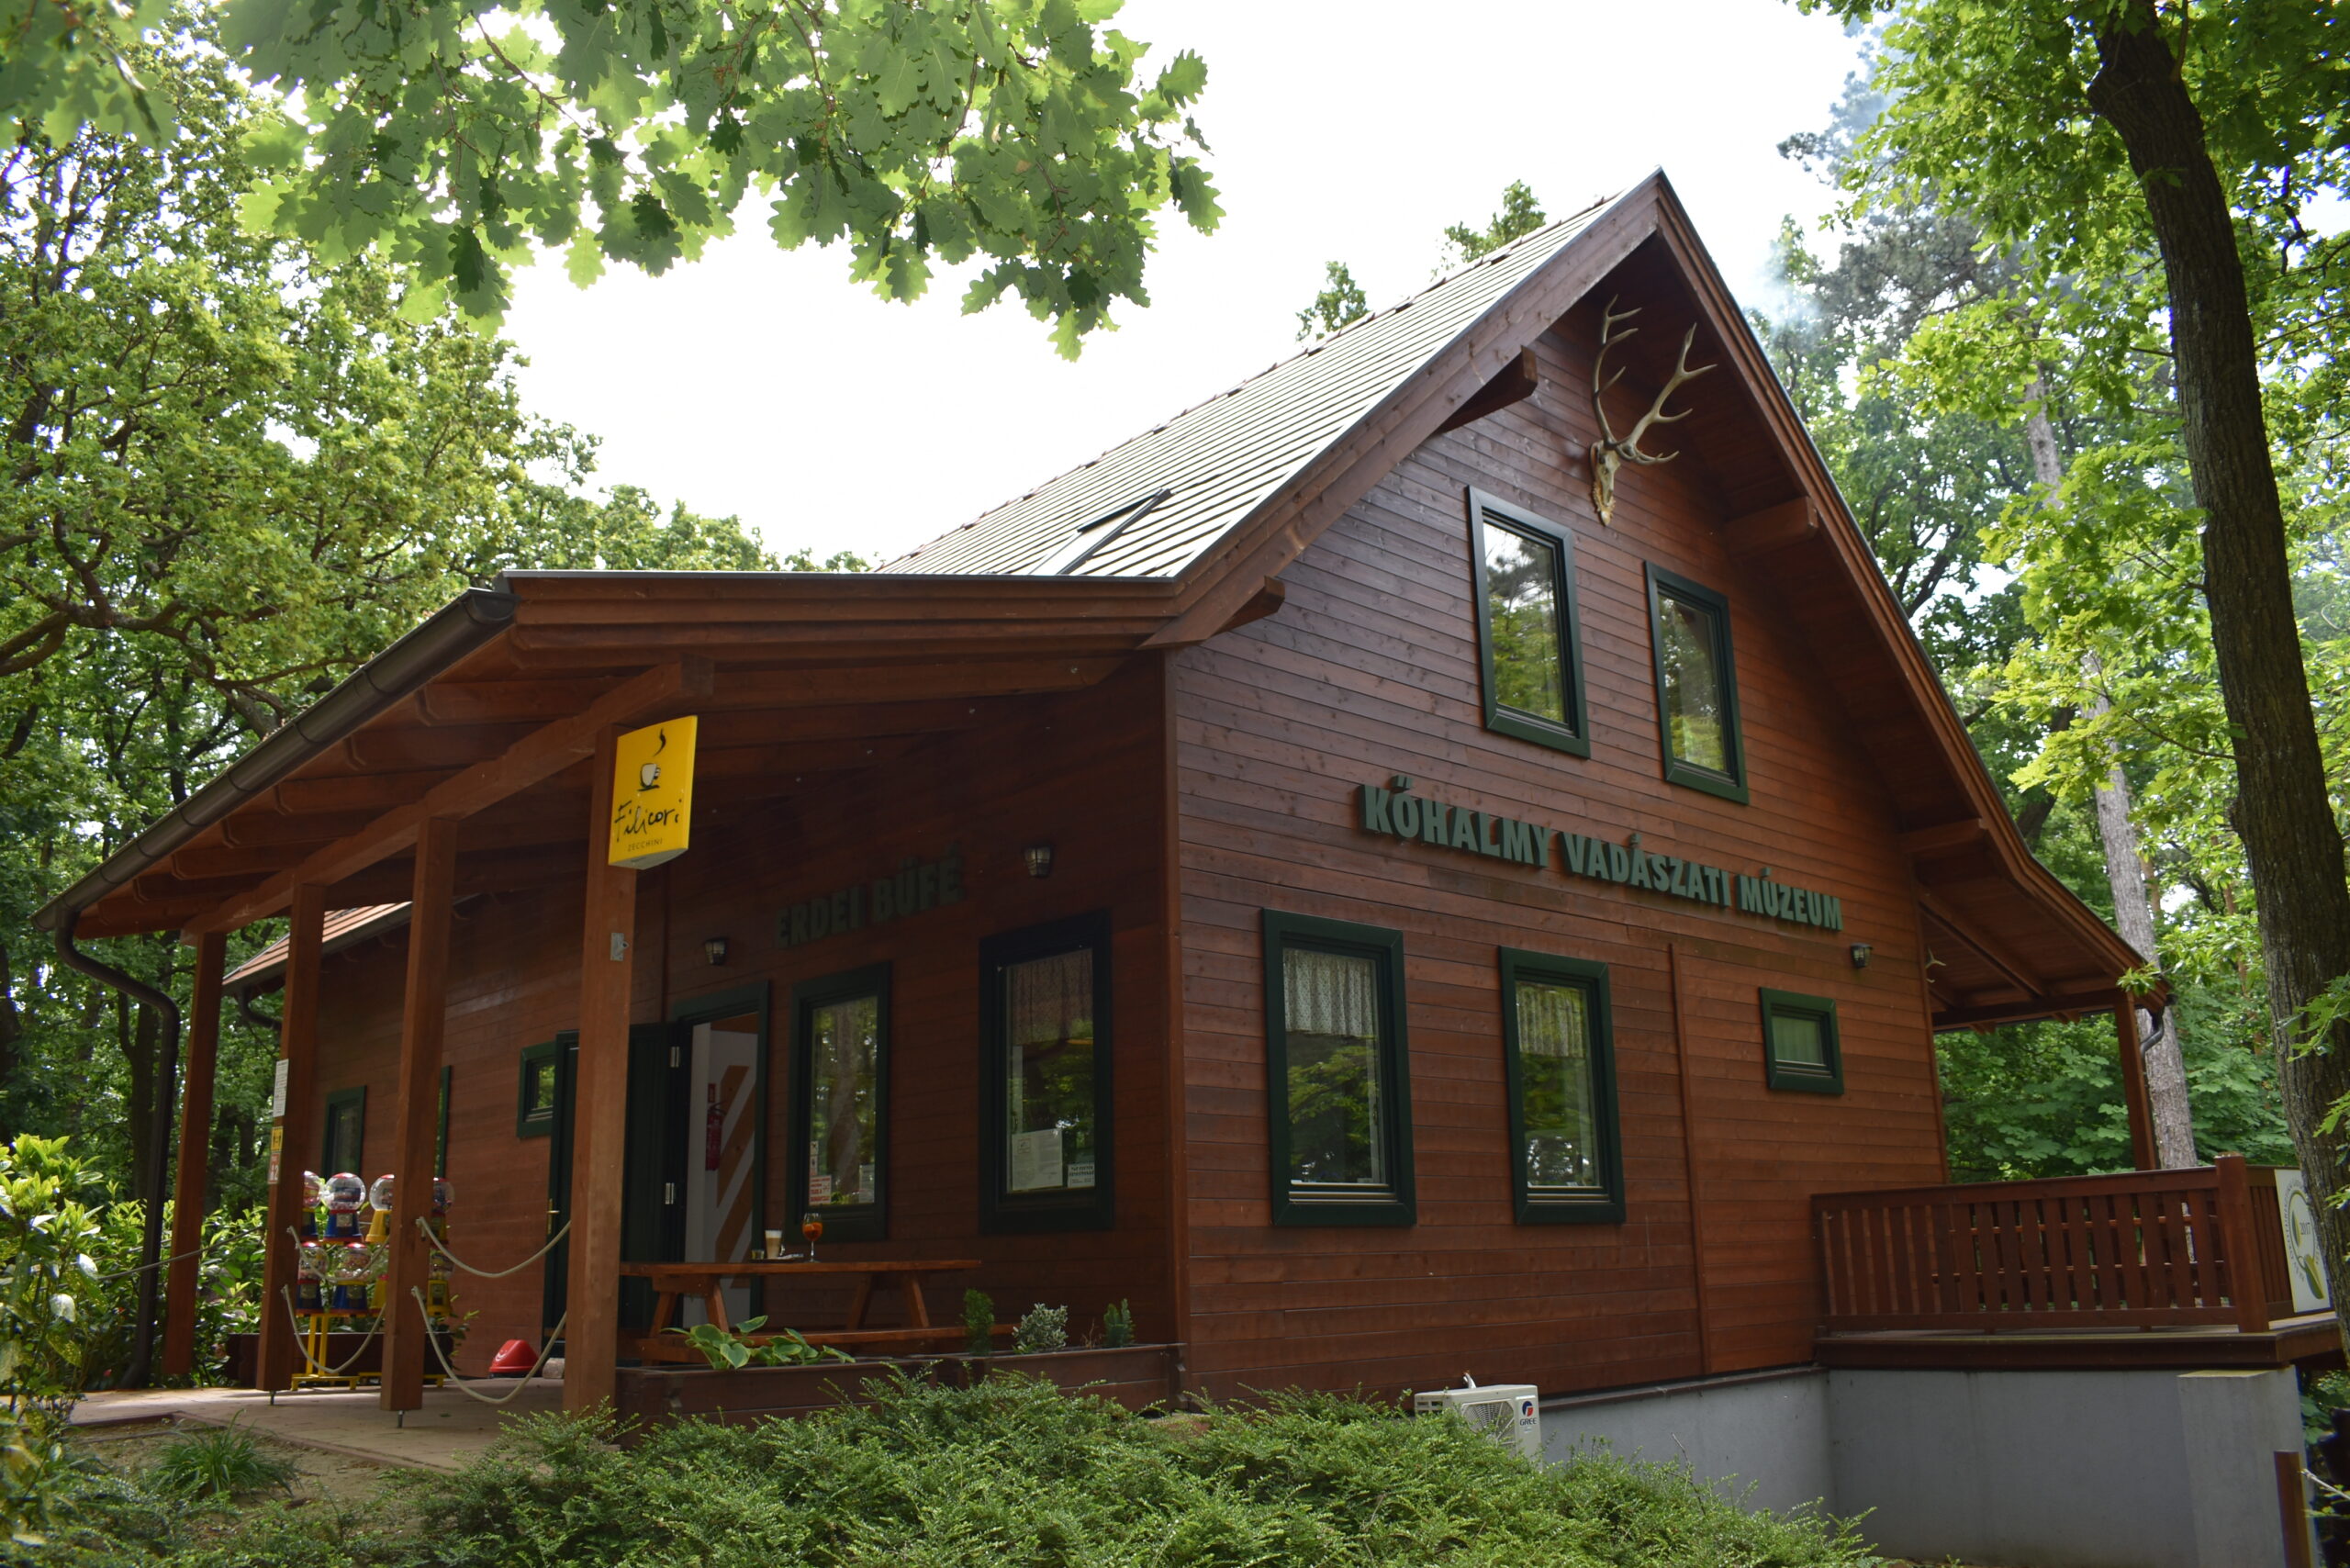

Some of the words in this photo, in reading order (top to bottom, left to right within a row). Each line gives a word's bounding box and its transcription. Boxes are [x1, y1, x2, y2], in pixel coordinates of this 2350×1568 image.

[614, 799, 682, 842] Filicori
[627, 837, 664, 852] ZECCHINI
[1358, 774, 1550, 868] KŐHALMY
[1557, 831, 1731, 907] VADÁSZATI
[1735, 867, 1844, 931] MÚZEUM
[775, 884, 866, 948] ERDEI
[871, 840, 966, 924] BÜFÉ
[1519, 1417, 1538, 1426] GREE
